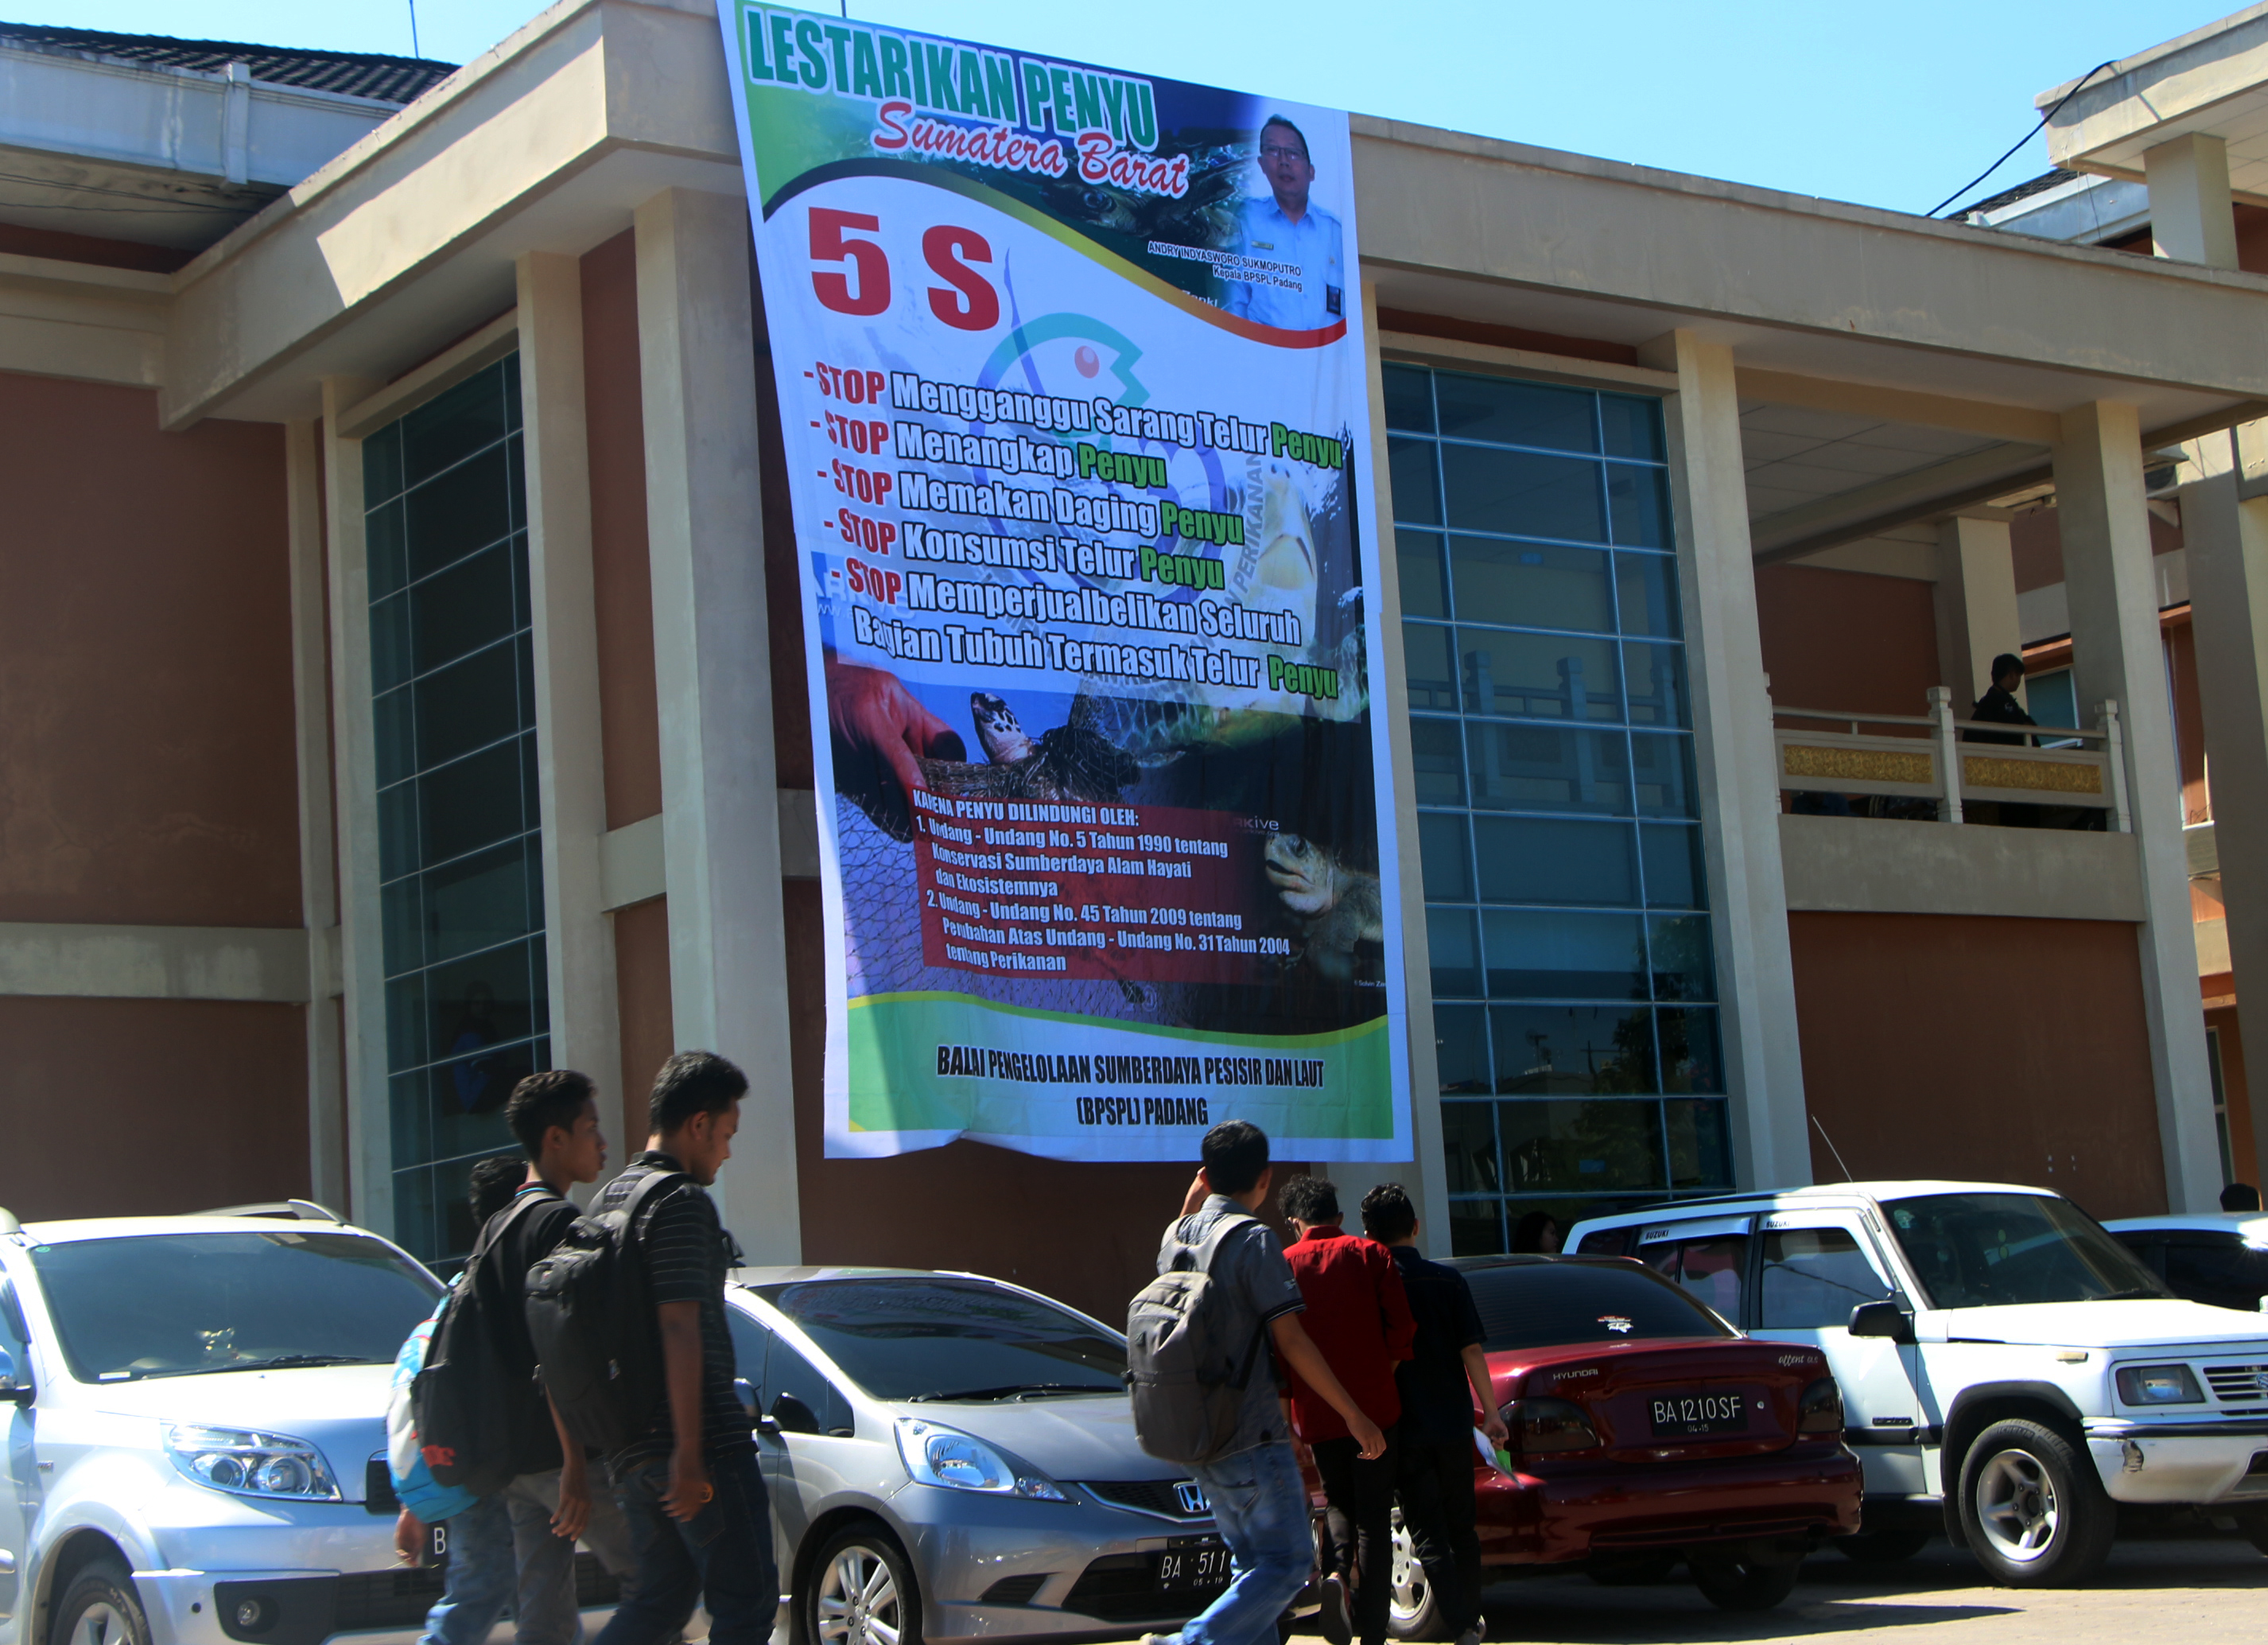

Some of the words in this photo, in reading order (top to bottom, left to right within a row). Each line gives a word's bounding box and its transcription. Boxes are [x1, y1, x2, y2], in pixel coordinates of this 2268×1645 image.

[745, 9, 1020, 124] LESTARIKAN
[1023, 60, 1155, 148] PENYU
[874, 101, 1065, 174] Sumatera
[1078, 133, 1186, 194] Barat
[808, 207, 891, 317] 5
[921, 224, 1000, 332] S
[1147, 241, 1180, 256] ANDRY
[1180, 247, 1241, 266] INDYASWORO
[1241, 256, 1302, 277] SUKMOPUTRO
[1213, 265, 1241, 281] Kepala
[1244, 270, 1272, 286] BPSPL
[1272, 277, 1303, 293] Padang
[815, 361, 885, 404] STOP
[891, 371, 1090, 433] Mengganggu
[1093, 398, 1196, 448] Sarang
[1197, 411, 1268, 455] Telur
[1271, 422, 1343, 469] Penyu
[825, 410, 889, 454] STOP
[895, 421, 1074, 479] Menangkap
[1078, 442, 1167, 488] Penyu
[832, 458, 892, 505] STOP
[898, 471, 1051, 523] Memakan
[1053, 488, 1158, 538] Daging
[1160, 500, 1245, 545] Penyu
[838, 508, 895, 555] STOP
[902, 522, 1058, 571] Konsumsi
[1060, 538, 1136, 581] Telur
[1140, 546, 1225, 590] Penyu
[846, 558, 901, 605] STOP
[907, 571, 1198, 635] Memperjualbelikan
[1200, 600, 1301, 646] Seluruh
[852, 605, 943, 663] Bagian
[945, 624, 1045, 669] Tubuh
[1047, 632, 1190, 682] Termasuk
[1190, 647, 1260, 689] Telur
[1268, 655, 1338, 700] Penyu
[956, 800, 1004, 820] PENYU
[1008, 803, 1097, 824] DILINDUNGI
[1100, 807, 1139, 826] OLEH:
[916, 815, 926, 833] 1.
[928, 818, 973, 846] Undang
[984, 827, 1046, 849] Undang
[1049, 830, 1074, 847] No.
[1076, 830, 1086, 848] 5
[1089, 831, 1135, 850] Tahun
[1137, 834, 1172, 853] 1990
[1175, 839, 1229, 858] tentang
[931, 842, 1001, 870] Konservasi
[1004, 853, 1105, 875] Sumberdaya
[1108, 858, 1144, 875] Alam
[1148, 859, 1191, 879] Hayati
[935, 868, 955, 888] dan
[956, 873, 1058, 898] Ekosistemnya
[926, 889, 938, 908] 2.
[938, 892, 981, 919] Undang
[990, 901, 1051, 923] Undang
[1053, 904, 1078, 922] No.
[1080, 904, 1100, 923] 45
[1102, 905, 1148, 924] Tahun
[1150, 907, 1186, 926] 2009
[1189, 911, 1242, 931] tentang
[990, 950, 1066, 971] Perikanan
[1008, 928, 1043, 946] Atas
[1046, 928, 1105, 949] Undang
[1117, 931, 1172, 951] Undang
[1175, 933, 1196, 951] No.
[1198, 934, 1214, 951] 31
[1216, 935, 1257, 954] Tahun
[1259, 938, 1290, 955] 2004
[937, 1045, 985, 1079] BALAI
[988, 1048, 1091, 1083] PENGELOLAAN
[1094, 1055, 1202, 1085] SUMBERDAYA
[1205, 1058, 1263, 1086] PESISIR
[1265, 1058, 1292, 1087] DAN
[1295, 1060, 1326, 1088] LAUT
[1144, 1096, 1209, 1126] PADANG
[1645, 1230, 1668, 1239] SUZUKI
[1553, 1368, 1598, 1380] HYUNDAI
[1654, 1401, 1677, 1423] BA
[1680, 1398, 1717, 1421] 1210
[1719, 1396, 1742, 1420] SF
[1161, 1555, 1181, 1578] BA
